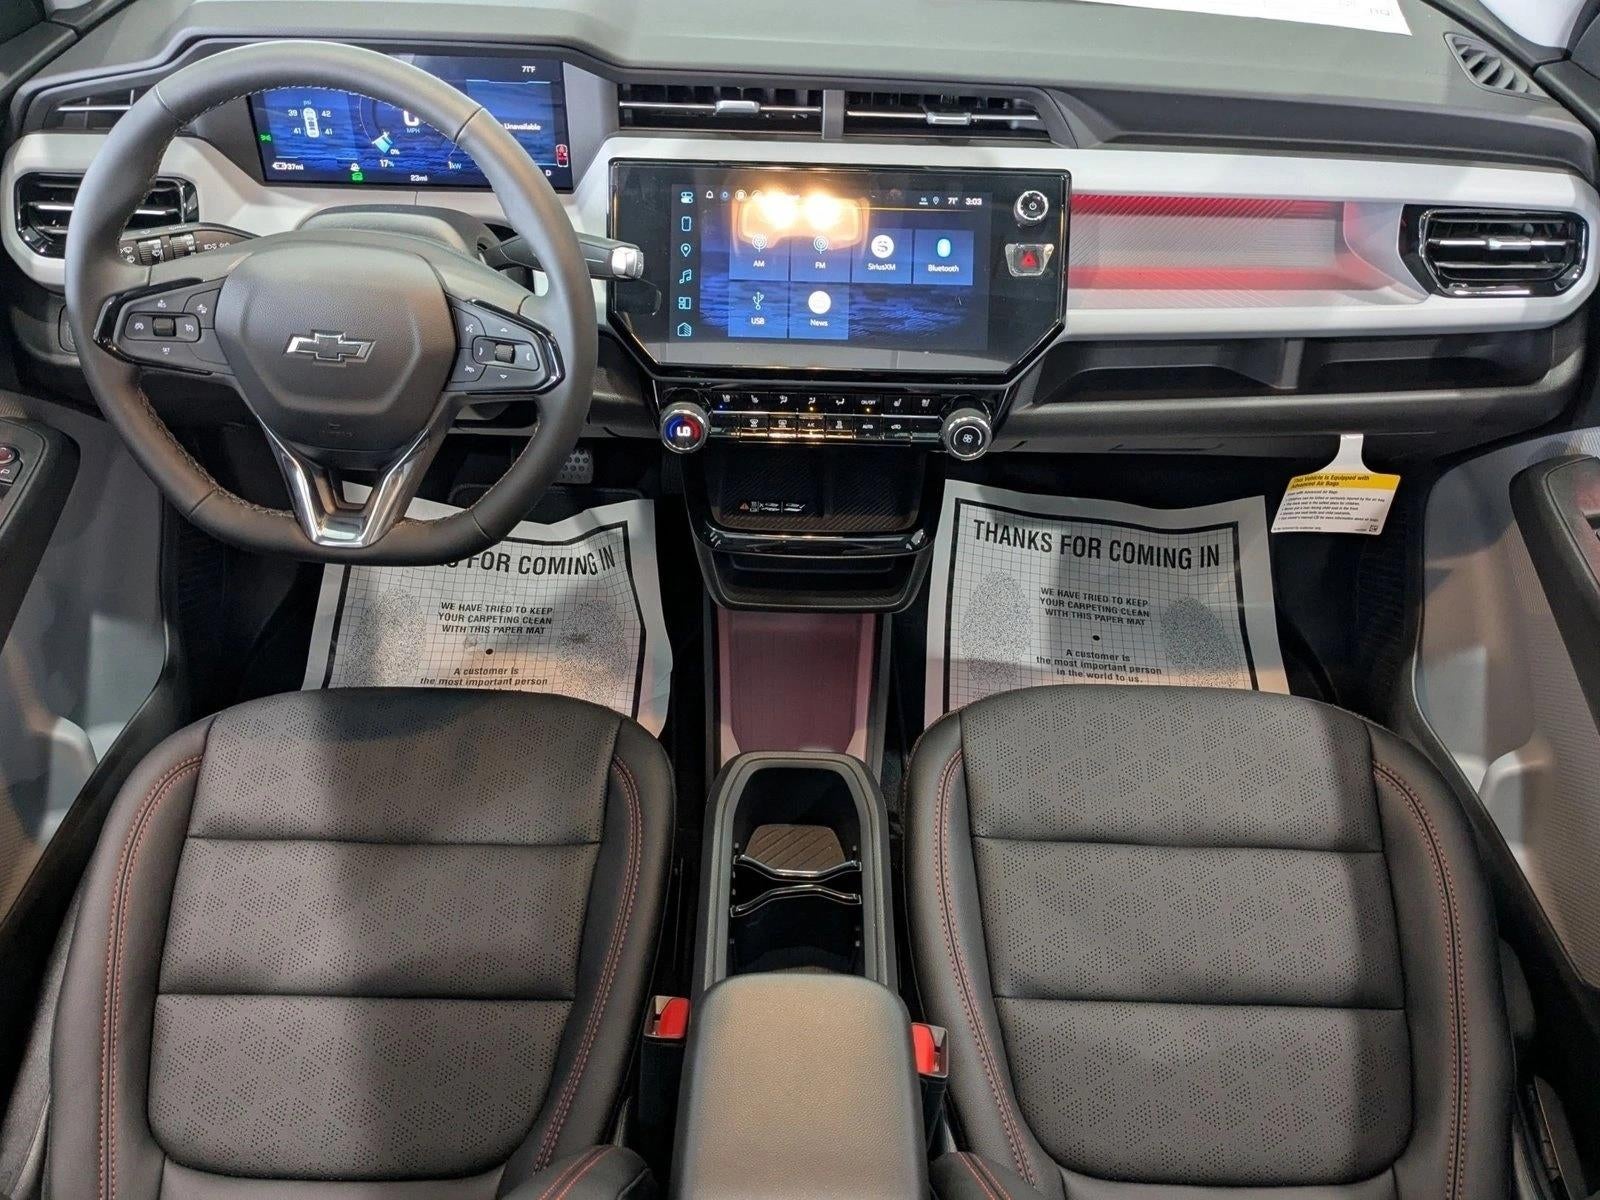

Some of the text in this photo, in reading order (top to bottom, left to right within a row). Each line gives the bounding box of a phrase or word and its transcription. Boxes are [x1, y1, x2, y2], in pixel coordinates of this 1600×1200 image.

[965, 197, 982, 205] 3:03
[867, 263, 896, 272] SiriusXM
[928, 264, 959, 273] Bluetooth
[810, 319, 828, 327] News
[974, 520, 1220, 570] THANKS FOR COMING IN
[467, 545, 616, 576] FOR COMING IN
[1041, 587, 1149, 607] WE HAVE TRIED TO KEEP
[441, 602, 455, 610] WE
[459, 603, 482, 612] HAVE
[485, 605, 512, 613] TRIED
[1040, 597, 1150, 617] YOUR CARPETING CLEAN
[438, 612, 552, 625] YOUR CARPETING CLEAN
[1045, 608, 1146, 626] WITH THIS PAPER MAT
[442, 625, 466, 633] WITH
[1075, 650, 1119, 661] customer
[1036, 656, 1162, 675] the most important person
[1069, 669, 1083, 678] the
[1086, 671, 1113, 680] world
[1116, 673, 1125, 682] to
[466, 677, 512, 687] important
[514, 678, 548, 687] person
